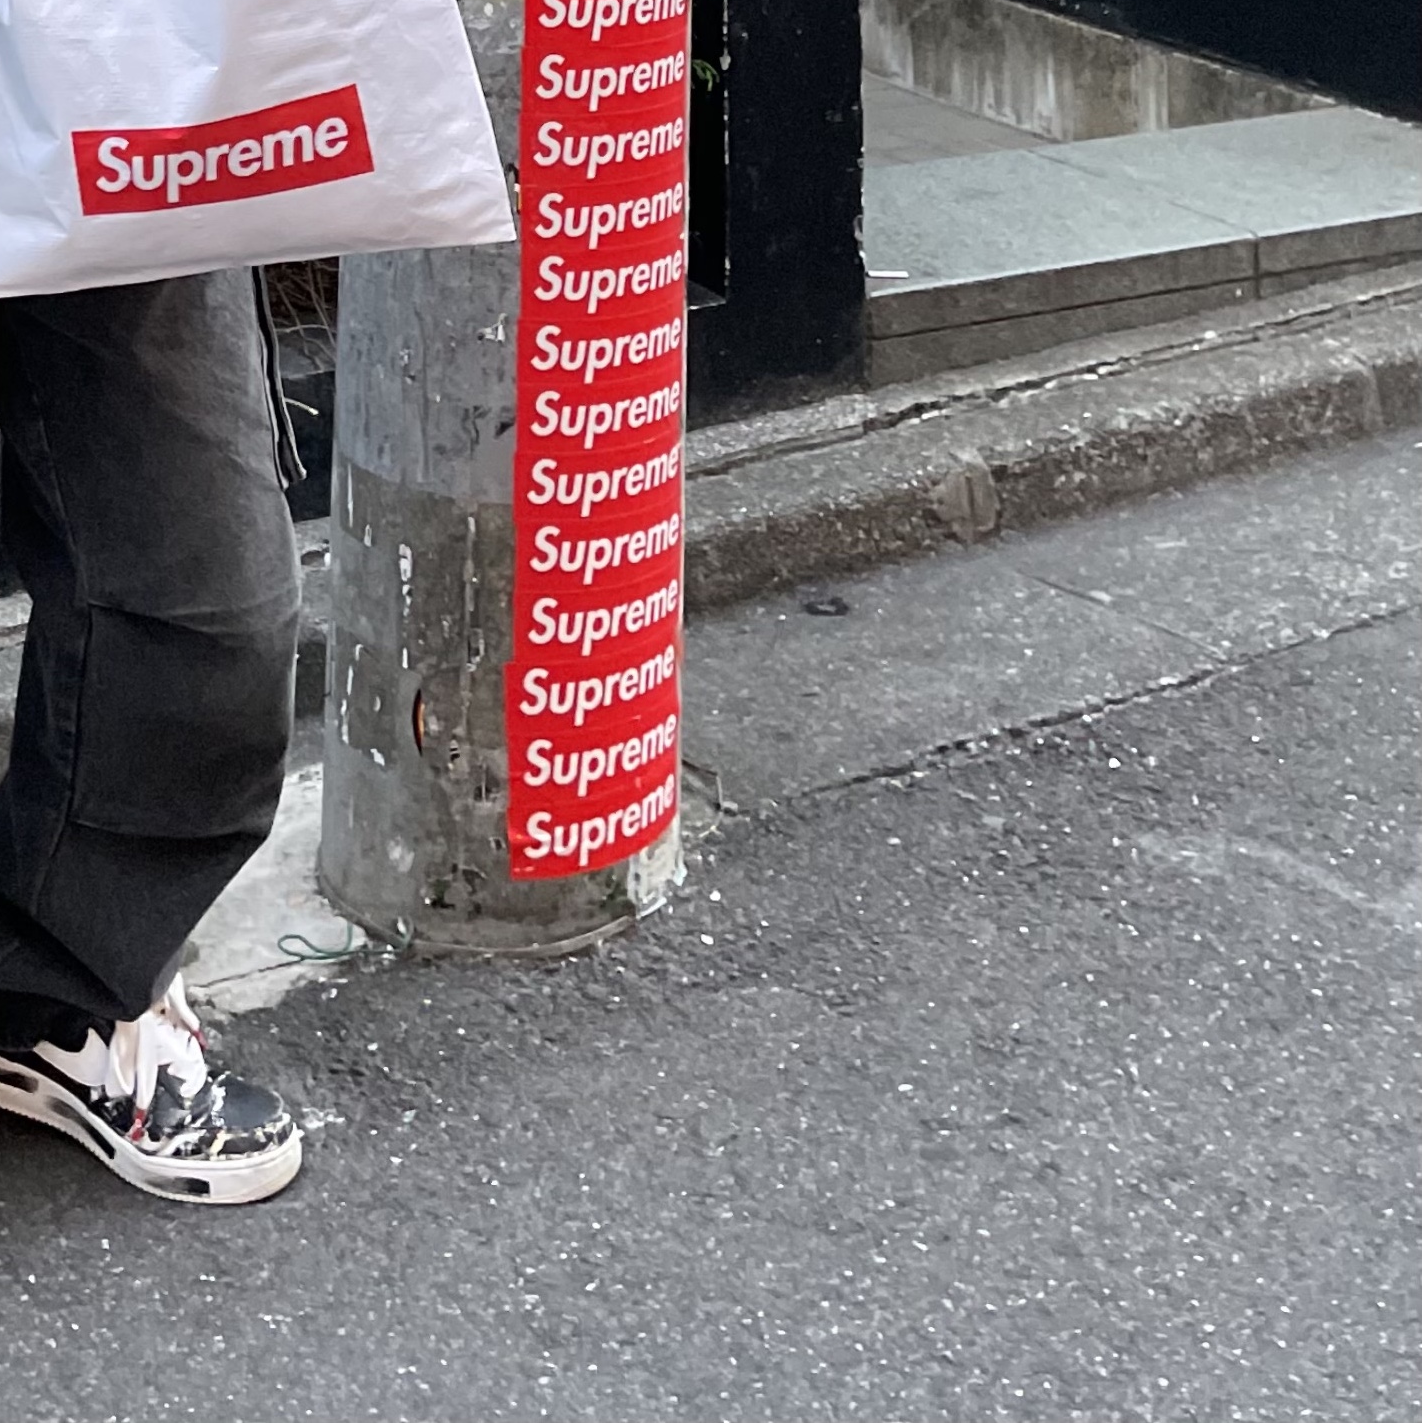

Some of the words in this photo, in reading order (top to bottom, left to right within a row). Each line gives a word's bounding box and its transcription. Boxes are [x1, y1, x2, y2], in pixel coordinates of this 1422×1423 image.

[535, 50, 685, 112] Supreme
[96, 117, 348, 203] Supreme
[533, 117, 684, 179] Supreme
[535, 182, 683, 250] Supreme
[534, 249, 682, 314] Supreme
[531, 317, 681, 384] Supreme
[531, 380, 680, 449] Supreme
[527, 443, 679, 517] Supreme
[529, 513, 679, 585] Supreme
[528, 578, 678, 656] Supreme
[520, 644, 675, 727] Supreme
[523, 714, 677, 796] Supreme
[524, 773, 675, 867] Supreme
